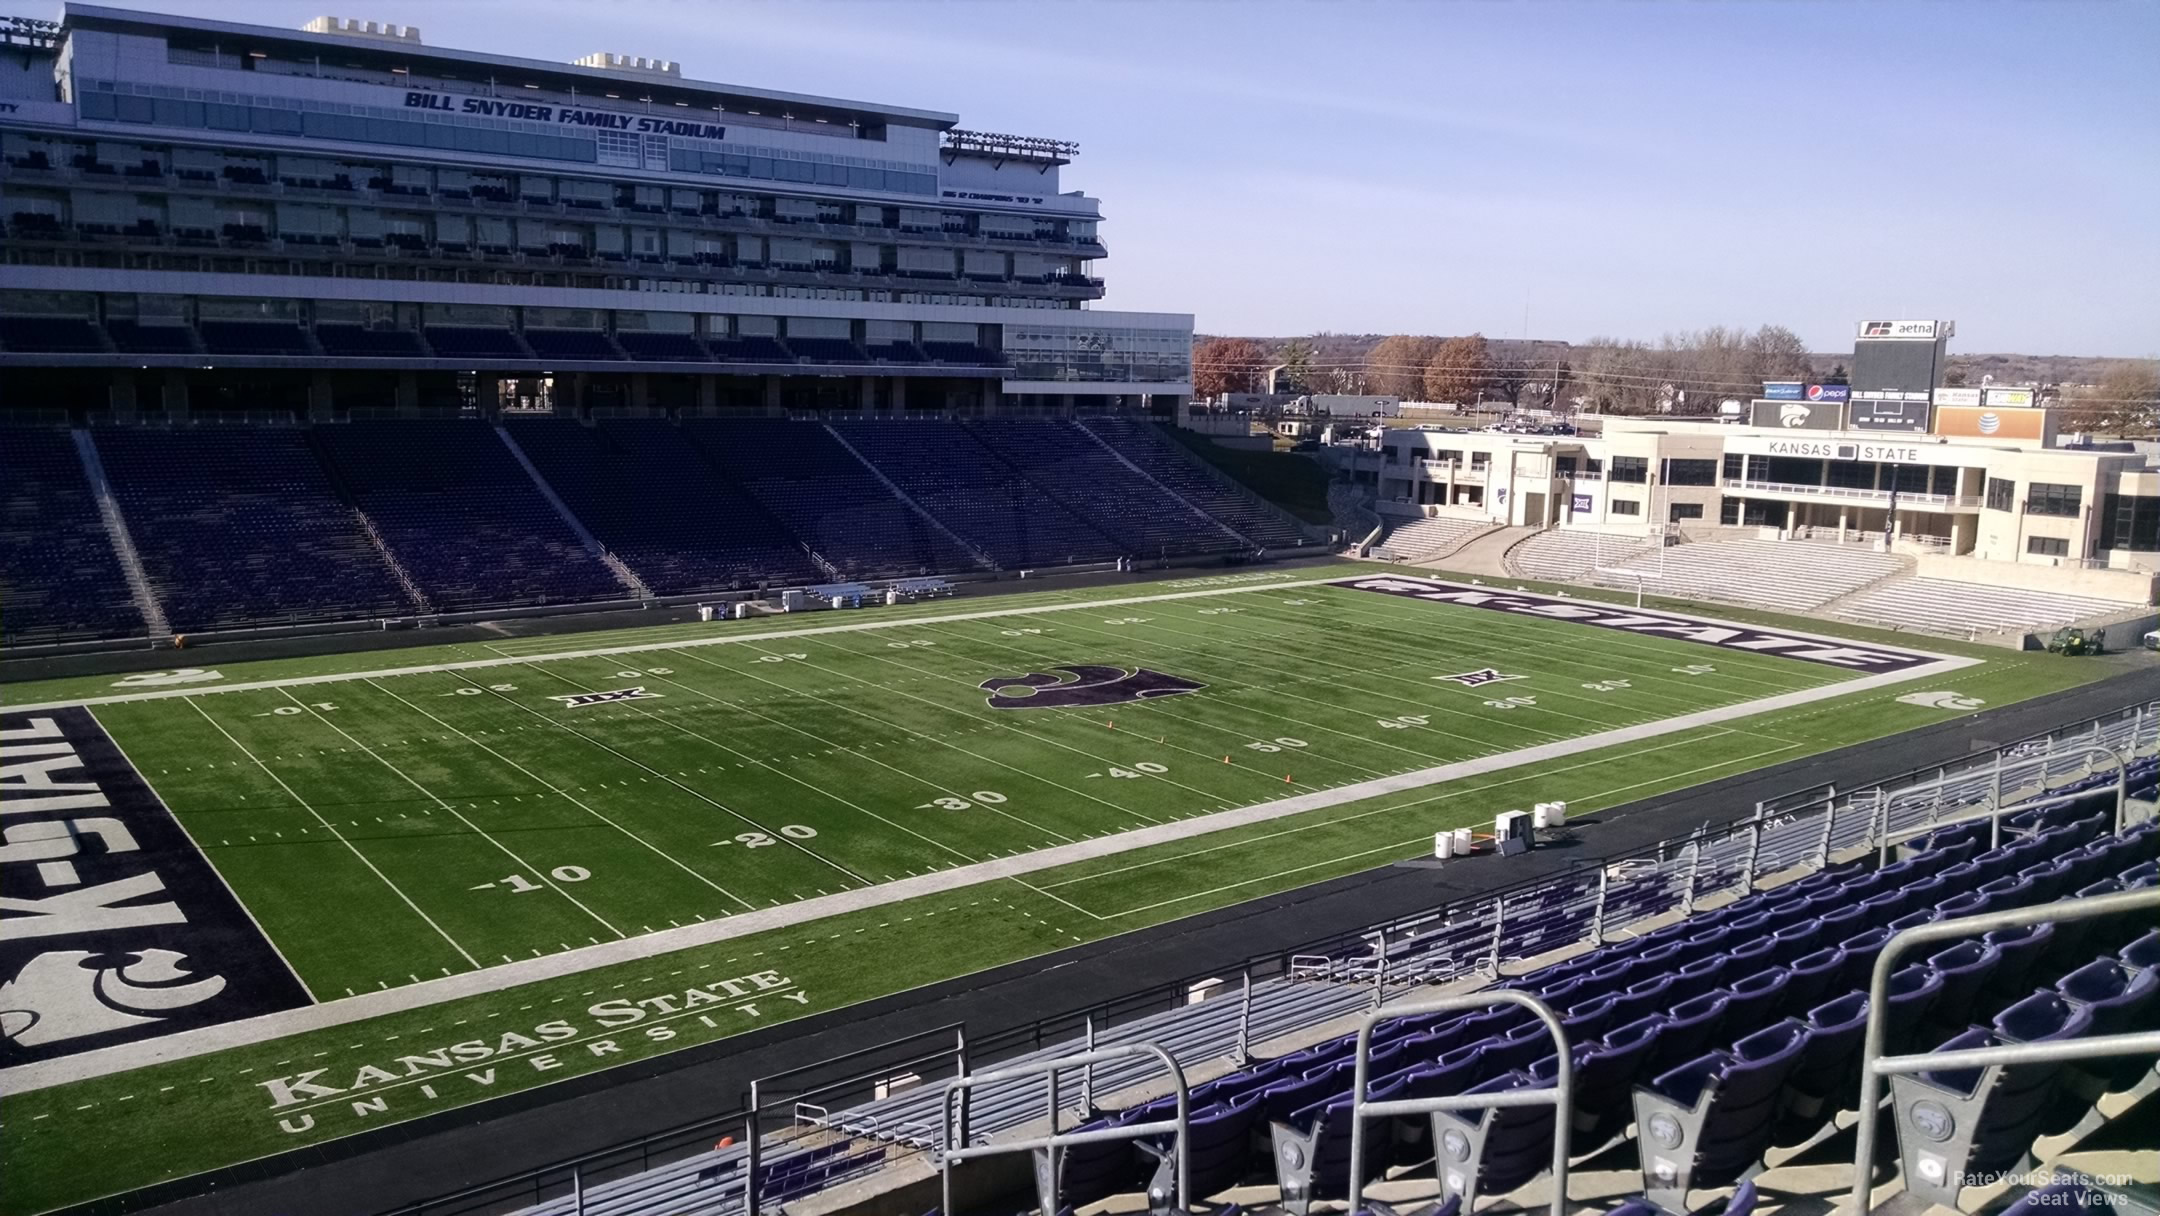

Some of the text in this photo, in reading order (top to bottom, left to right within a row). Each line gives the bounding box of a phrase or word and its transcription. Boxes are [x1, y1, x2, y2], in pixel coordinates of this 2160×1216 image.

[405, 92, 727, 140] BILL SNYDER FAMILY STADIUM
[1899, 324, 1933, 333] aetna
[1823, 389, 1847, 398] pepsi
[1769, 442, 1917, 461] KANSAS STATE
[256, 970, 791, 1108] KANSAS STATE
[279, 991, 809, 1134] UNIVERSITY
